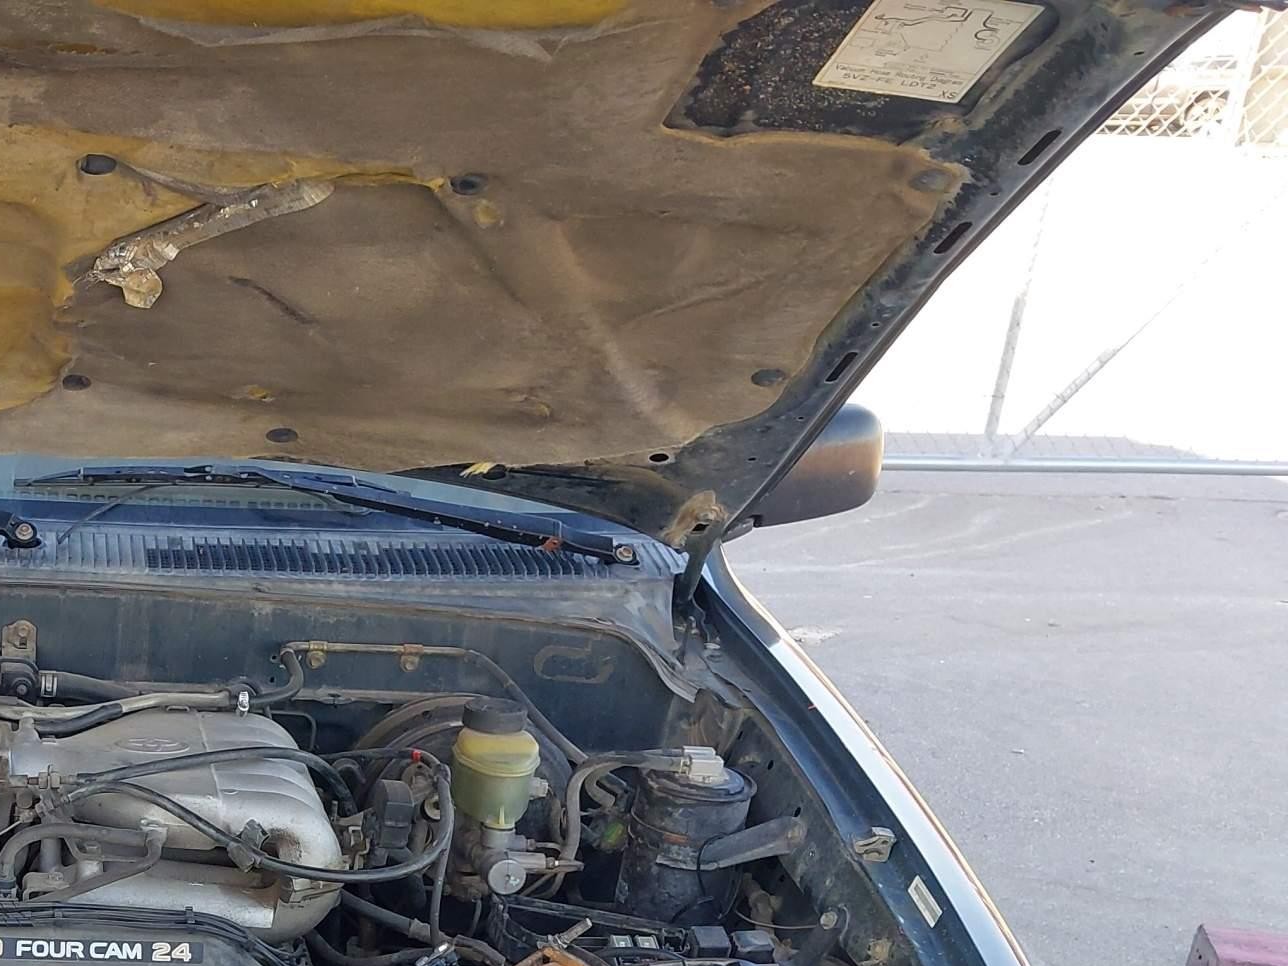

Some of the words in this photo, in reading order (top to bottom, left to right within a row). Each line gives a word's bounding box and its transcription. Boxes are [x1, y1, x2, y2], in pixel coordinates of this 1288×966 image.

[16, 940, 87, 959] FOUR
[89, 942, 143, 960] CAM
[151, 943, 192, 962] 24
